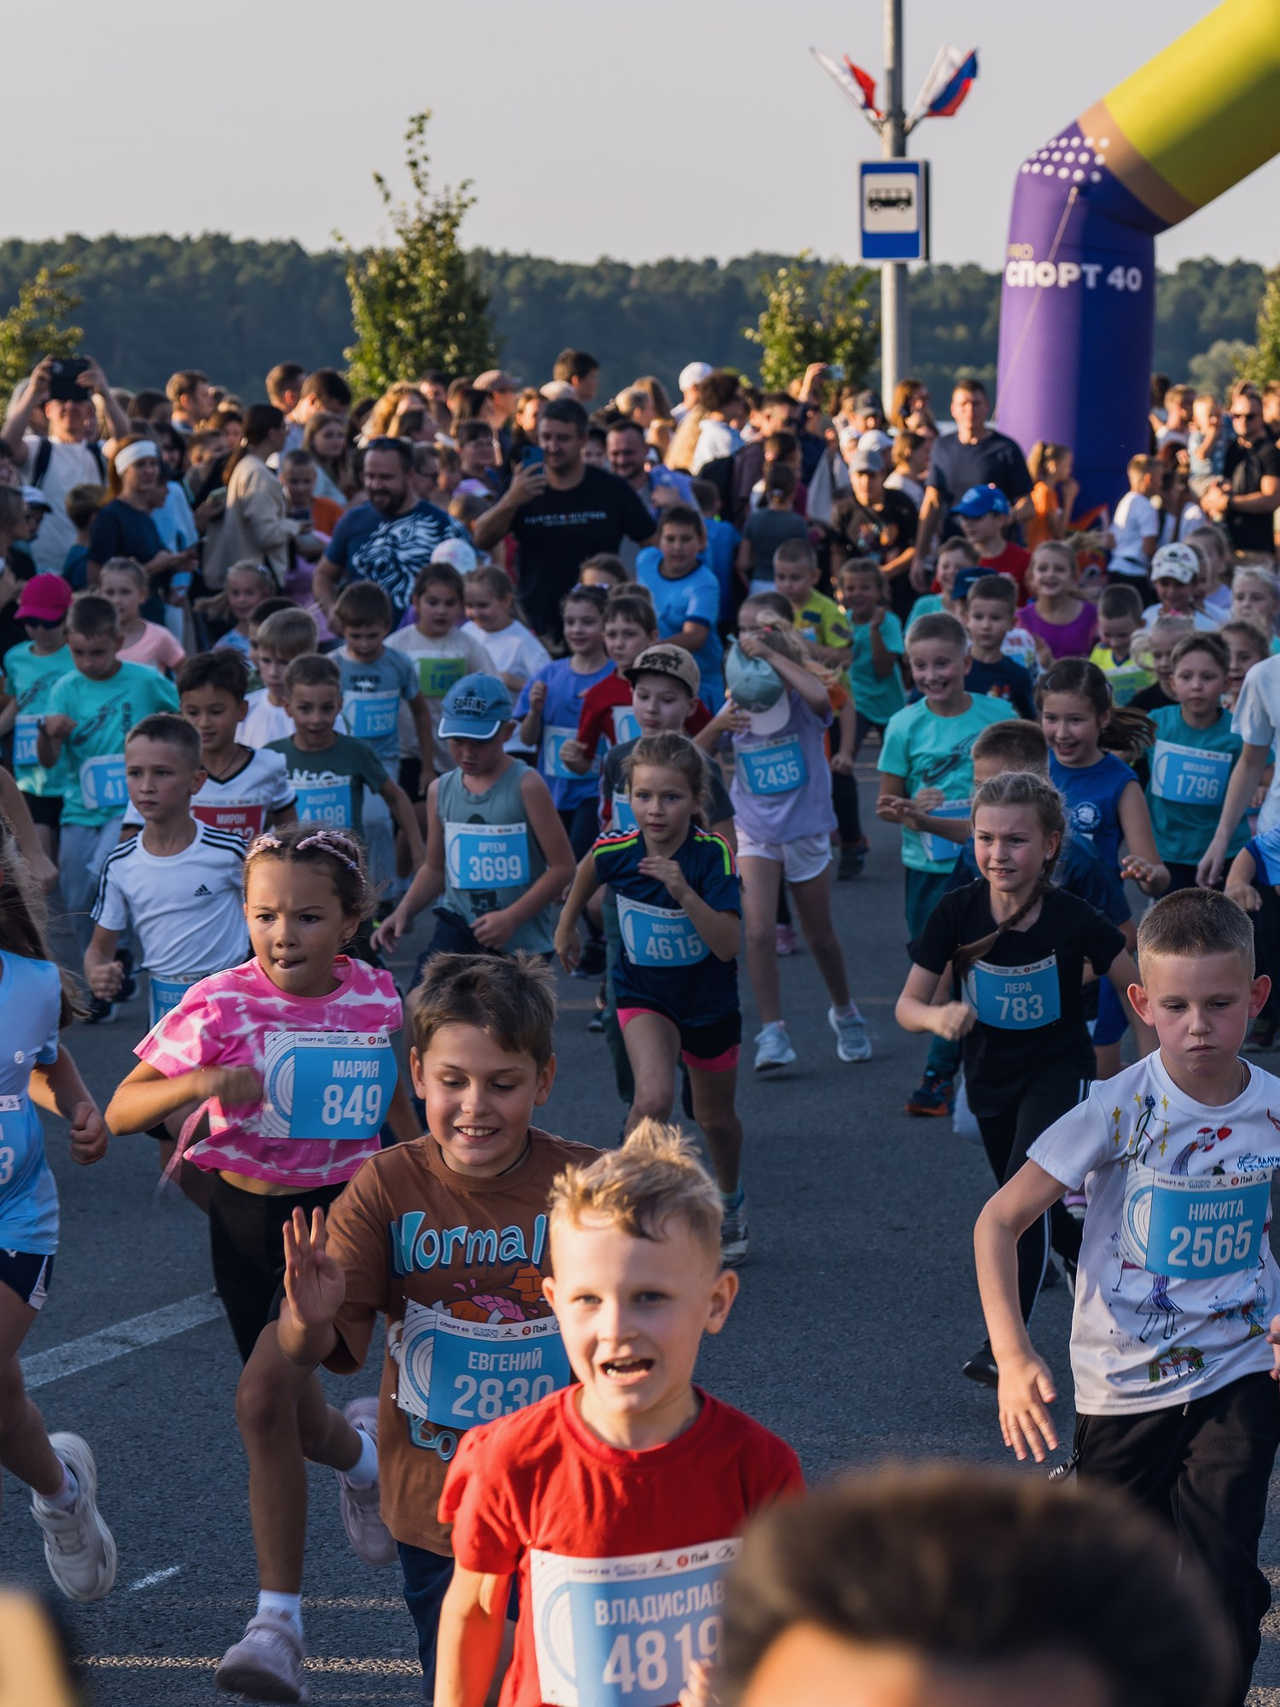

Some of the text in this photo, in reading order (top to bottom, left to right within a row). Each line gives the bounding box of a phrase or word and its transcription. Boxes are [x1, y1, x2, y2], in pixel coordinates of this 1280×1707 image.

[1005, 260, 1143, 292] СПОРТ 40
[754, 761, 800, 788] 2435
[1177, 774, 1220, 799] 1796
[216, 814, 246, 825] МИРОН
[468, 855, 523, 882] 3699
[645, 933, 702, 960] 4615
[1004, 982, 1033, 994] ЛЕРА
[995, 994, 1044, 1022] 783
[332, 1060, 380, 1078] МАРИЯ
[321, 1084, 383, 1126] 849
[1188, 1199, 1244, 1222] НИКИТА
[389, 1210, 549, 1275] Normal
[1167, 1219, 1254, 1267] 2565
[439, 1321, 460, 1331] СПОРТ
[532, 1324, 548, 1334] Пэй
[467, 1347, 543, 1372] ЕВГЕНИЙ
[594, 1579, 726, 1626] ВЛАДИСЛАВ
[602, 1615, 724, 1693] 4819
